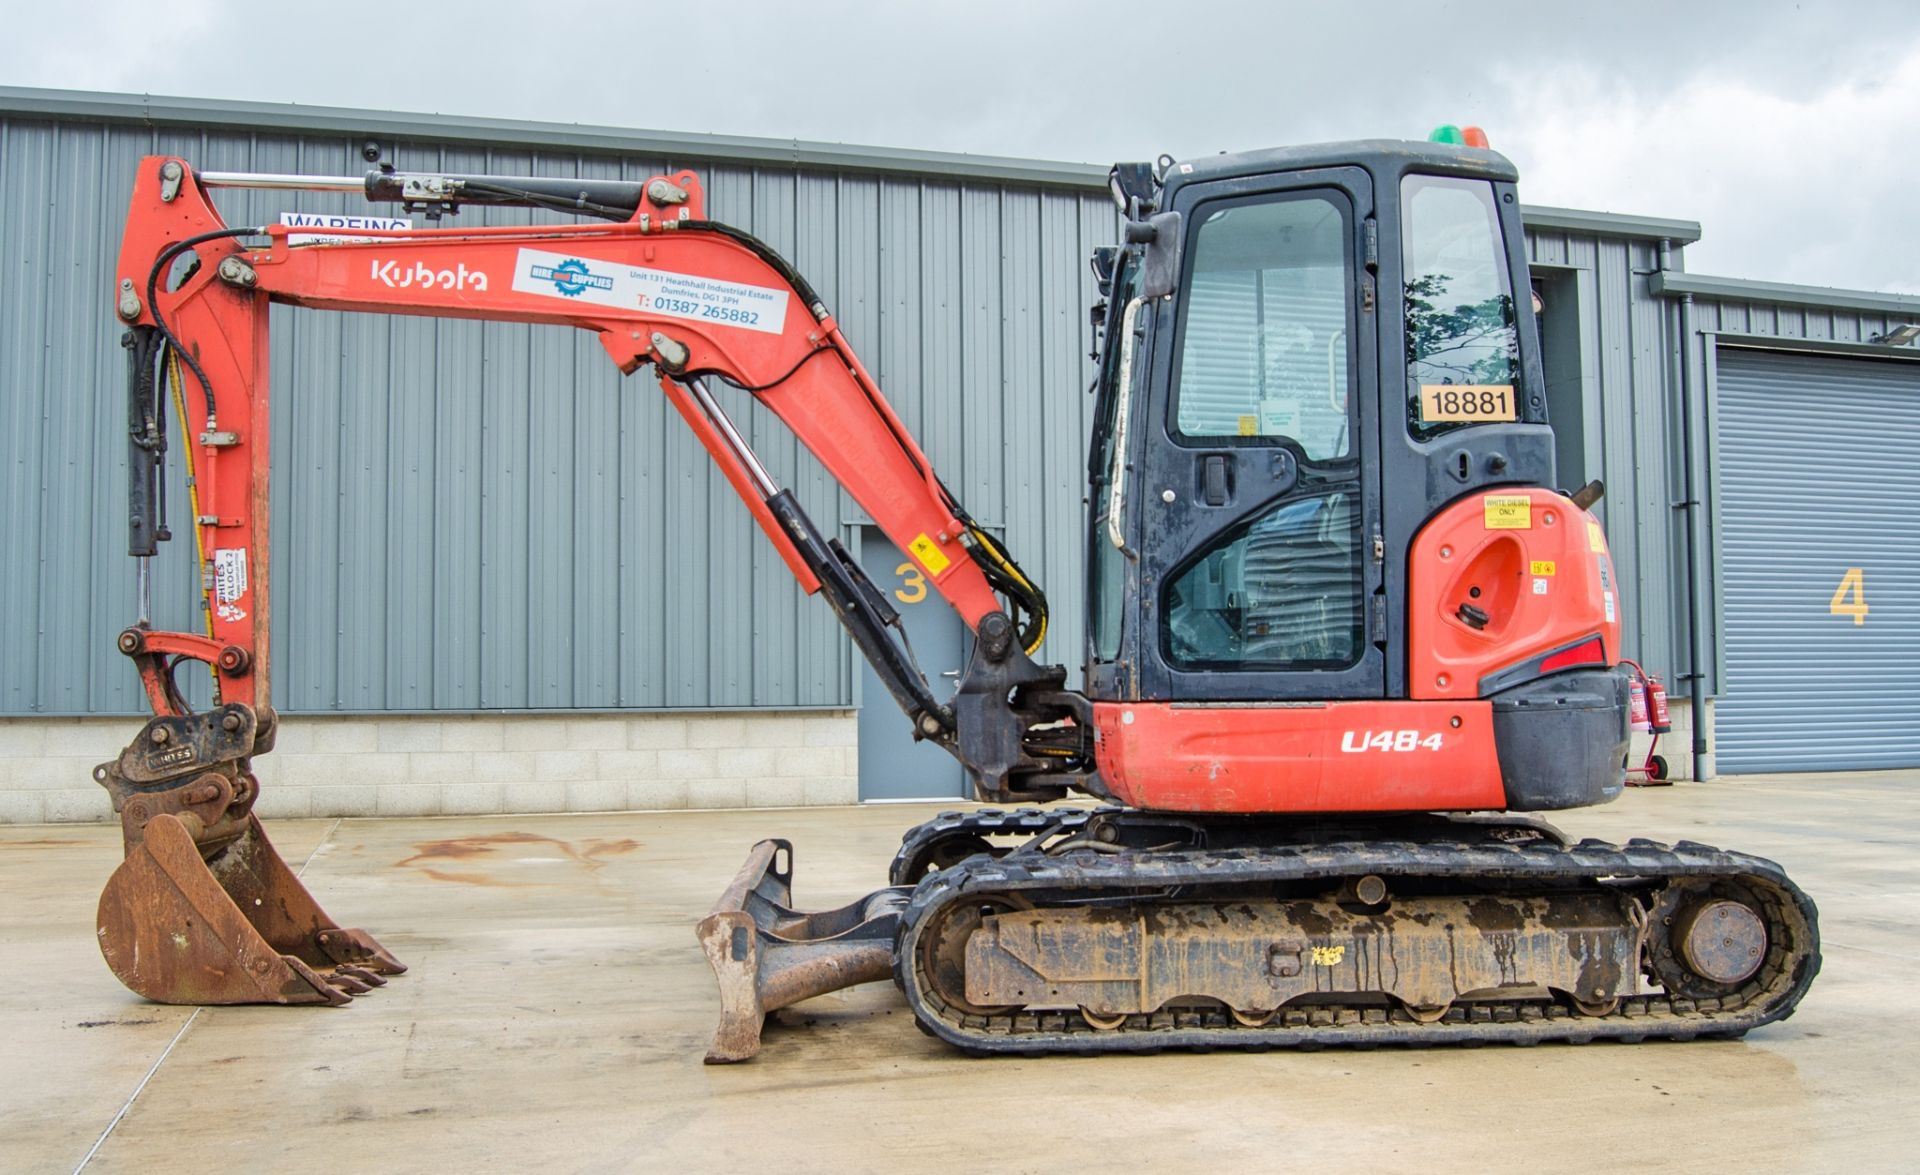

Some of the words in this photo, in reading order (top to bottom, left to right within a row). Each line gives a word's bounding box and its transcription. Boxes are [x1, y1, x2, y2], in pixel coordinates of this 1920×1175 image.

[371, 259, 488, 291] Kubota
[571, 273, 612, 289] SUPPLIES
[630, 271, 647, 280] Unit
[650, 274, 663, 283] 131
[666, 276, 705, 290] Heathhall
[707, 283, 746, 296] Industrial
[748, 290, 774, 301] Estate
[637, 294, 650, 307] T:
[654, 297, 699, 314] 01387
[701, 304, 759, 325] 265882
[702, 293, 720, 302] DG1
[722, 296, 739, 305] 3PH
[1431, 391, 1506, 414] 18881
[1487, 499, 1505, 507] WHITE
[1508, 499, 1529, 507] DIESEL
[1499, 508, 1515, 516] ONLY
[895, 562, 927, 604] 3
[1829, 567, 1869, 625] 4
[1341, 729, 1443, 753] U48-4
